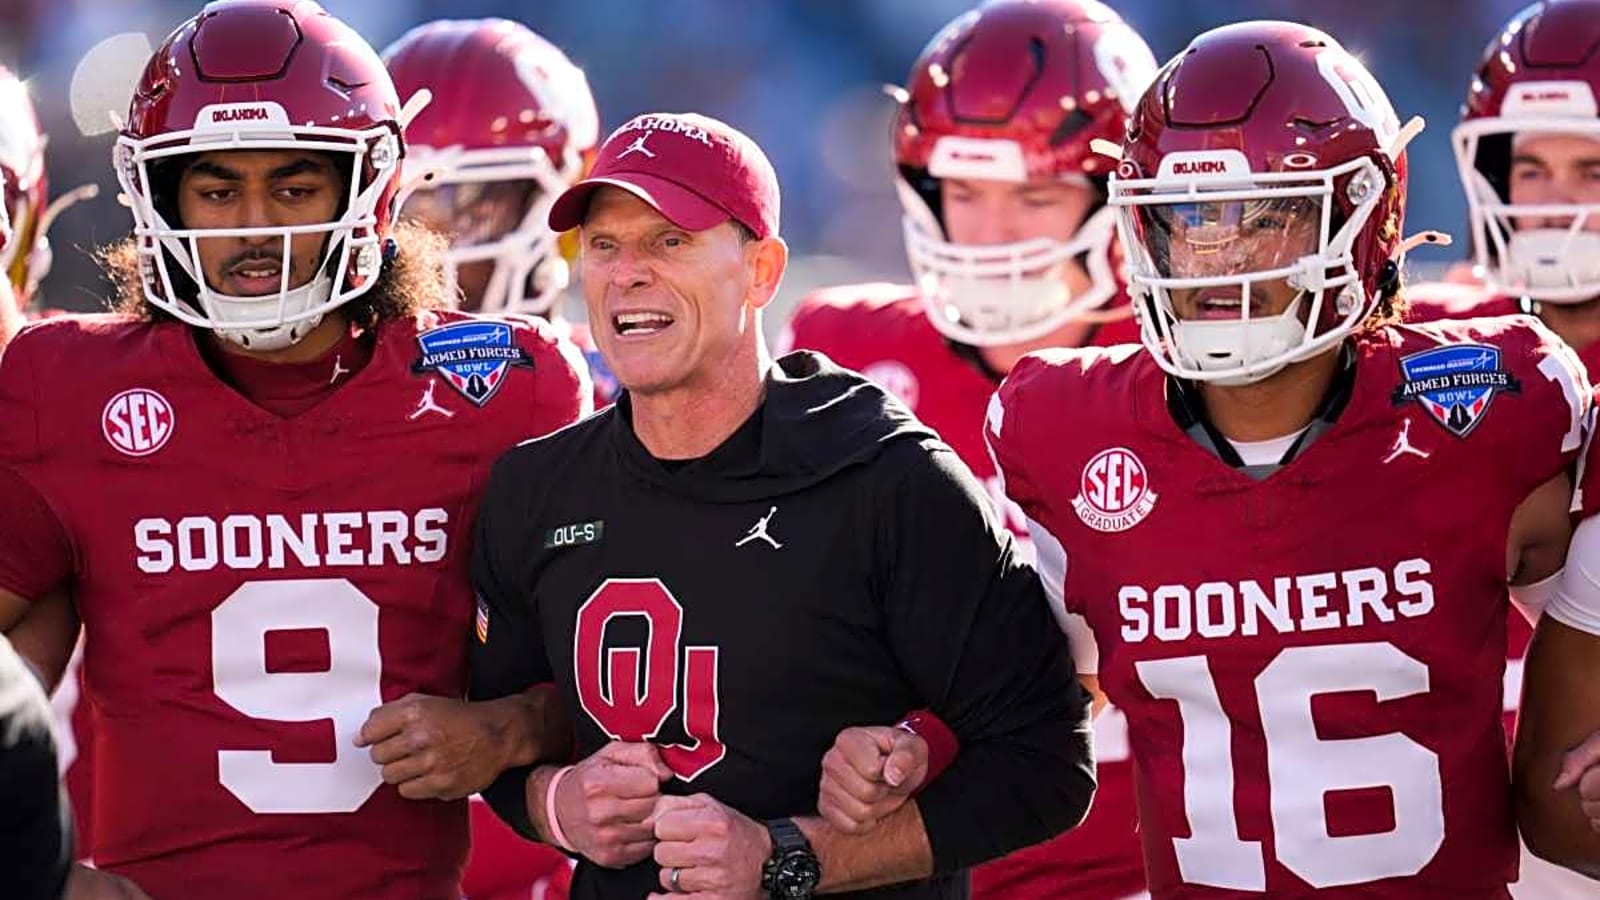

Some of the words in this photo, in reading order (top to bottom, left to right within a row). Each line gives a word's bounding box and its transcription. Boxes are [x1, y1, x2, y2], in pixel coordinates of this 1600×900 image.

[212, 108, 269, 122] OKLAHOMA
[1173, 160, 1227, 174] OKLAHOMA
[422, 350, 466, 366] ARMED
[469, 347, 520, 360] FORCES
[456, 362, 492, 373] BOWL
[1403, 375, 1450, 395] ARMED
[1453, 372, 1508, 385] FORCES
[1437, 390, 1476, 402] BOWL
[108, 393, 168, 450] SEC
[1087, 453, 1141, 511] SEC
[1080, 505, 1146, 530] GRADUATE
[133, 507, 449, 574] SOONERS
[553, 523, 595, 545] OU-S
[1117, 557, 1436, 643] SOONERS
[574, 578, 727, 783] OU
[211, 577, 385, 815] 9
[1134, 641, 1446, 893] 16
